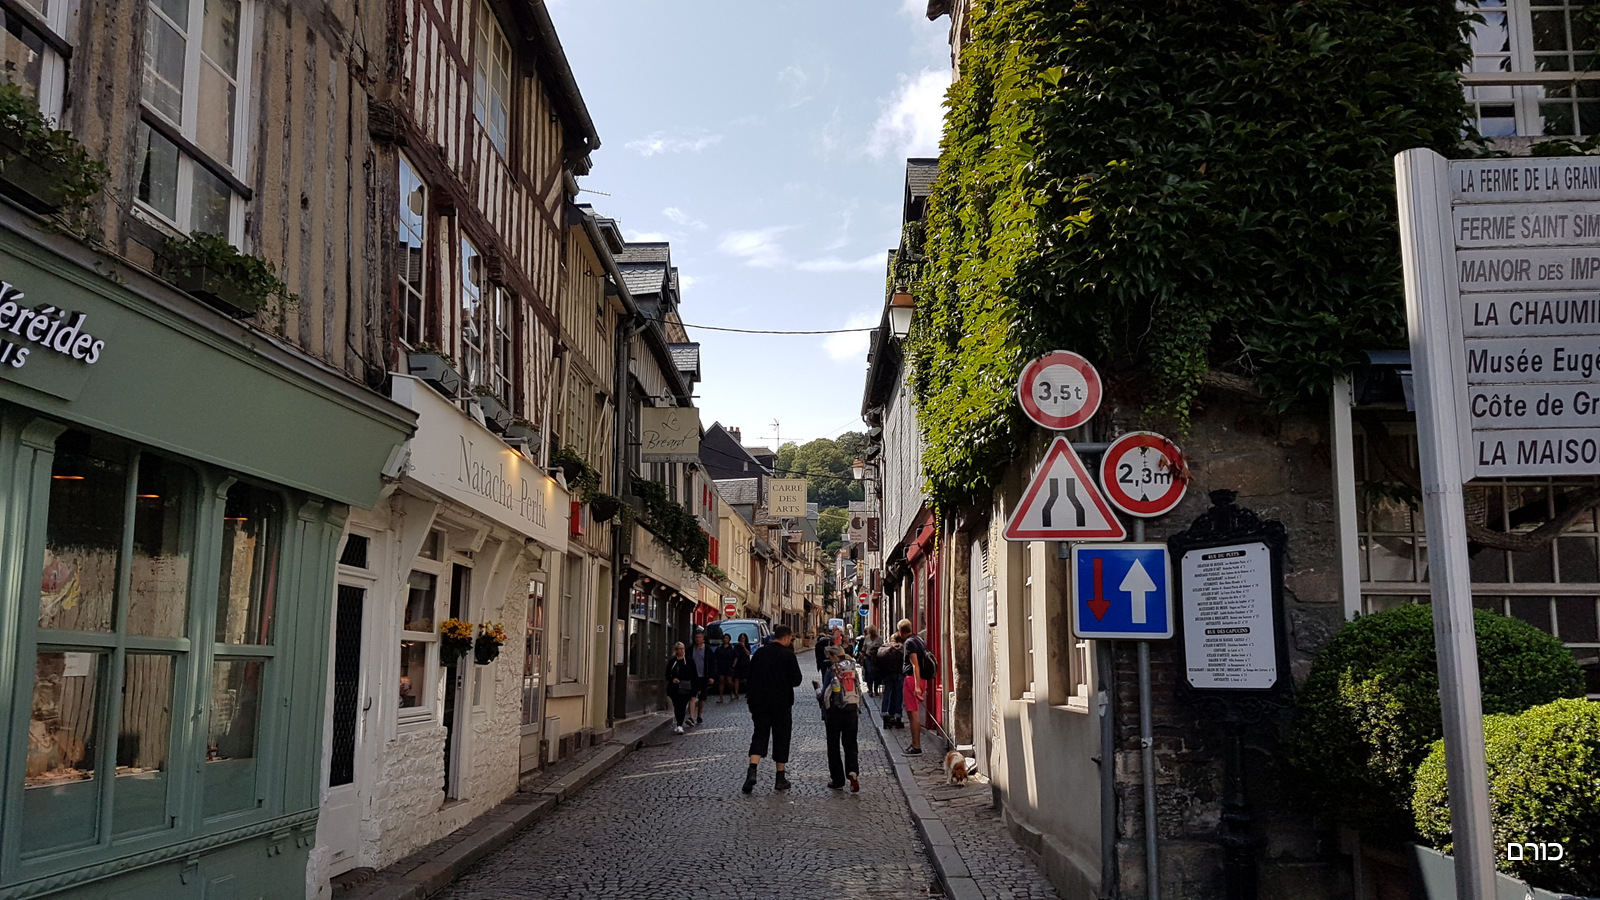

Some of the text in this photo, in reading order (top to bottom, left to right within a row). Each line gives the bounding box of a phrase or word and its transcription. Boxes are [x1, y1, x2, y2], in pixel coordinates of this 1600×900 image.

[1460, 168, 1474, 193] LA
[1480, 168, 1519, 192] FERME
[1525, 167, 1539, 191] DE
[1545, 167, 1560, 190] LA
[1460, 216, 1516, 240] FERME
[1521, 215, 1568, 239] SAINT
[1461, 259, 1531, 283] MANOIR
[1538, 264, 1564, 281] DES
[1474, 302, 1498, 326] LA
[1468, 348, 1543, 374] Musée
[1472, 393, 1527, 418] Côte
[1536, 393, 1564, 416] de
[661, 411, 681, 432] Le
[643, 428, 698, 450] Bréard
[1479, 439, 1600, 466] LA MAISO
[457, 434, 548, 530] Natacha Perlik
[772, 482, 804, 492] CARRÉ
[775, 505, 800, 513] ARTS
[778, 495, 797, 503] DES
